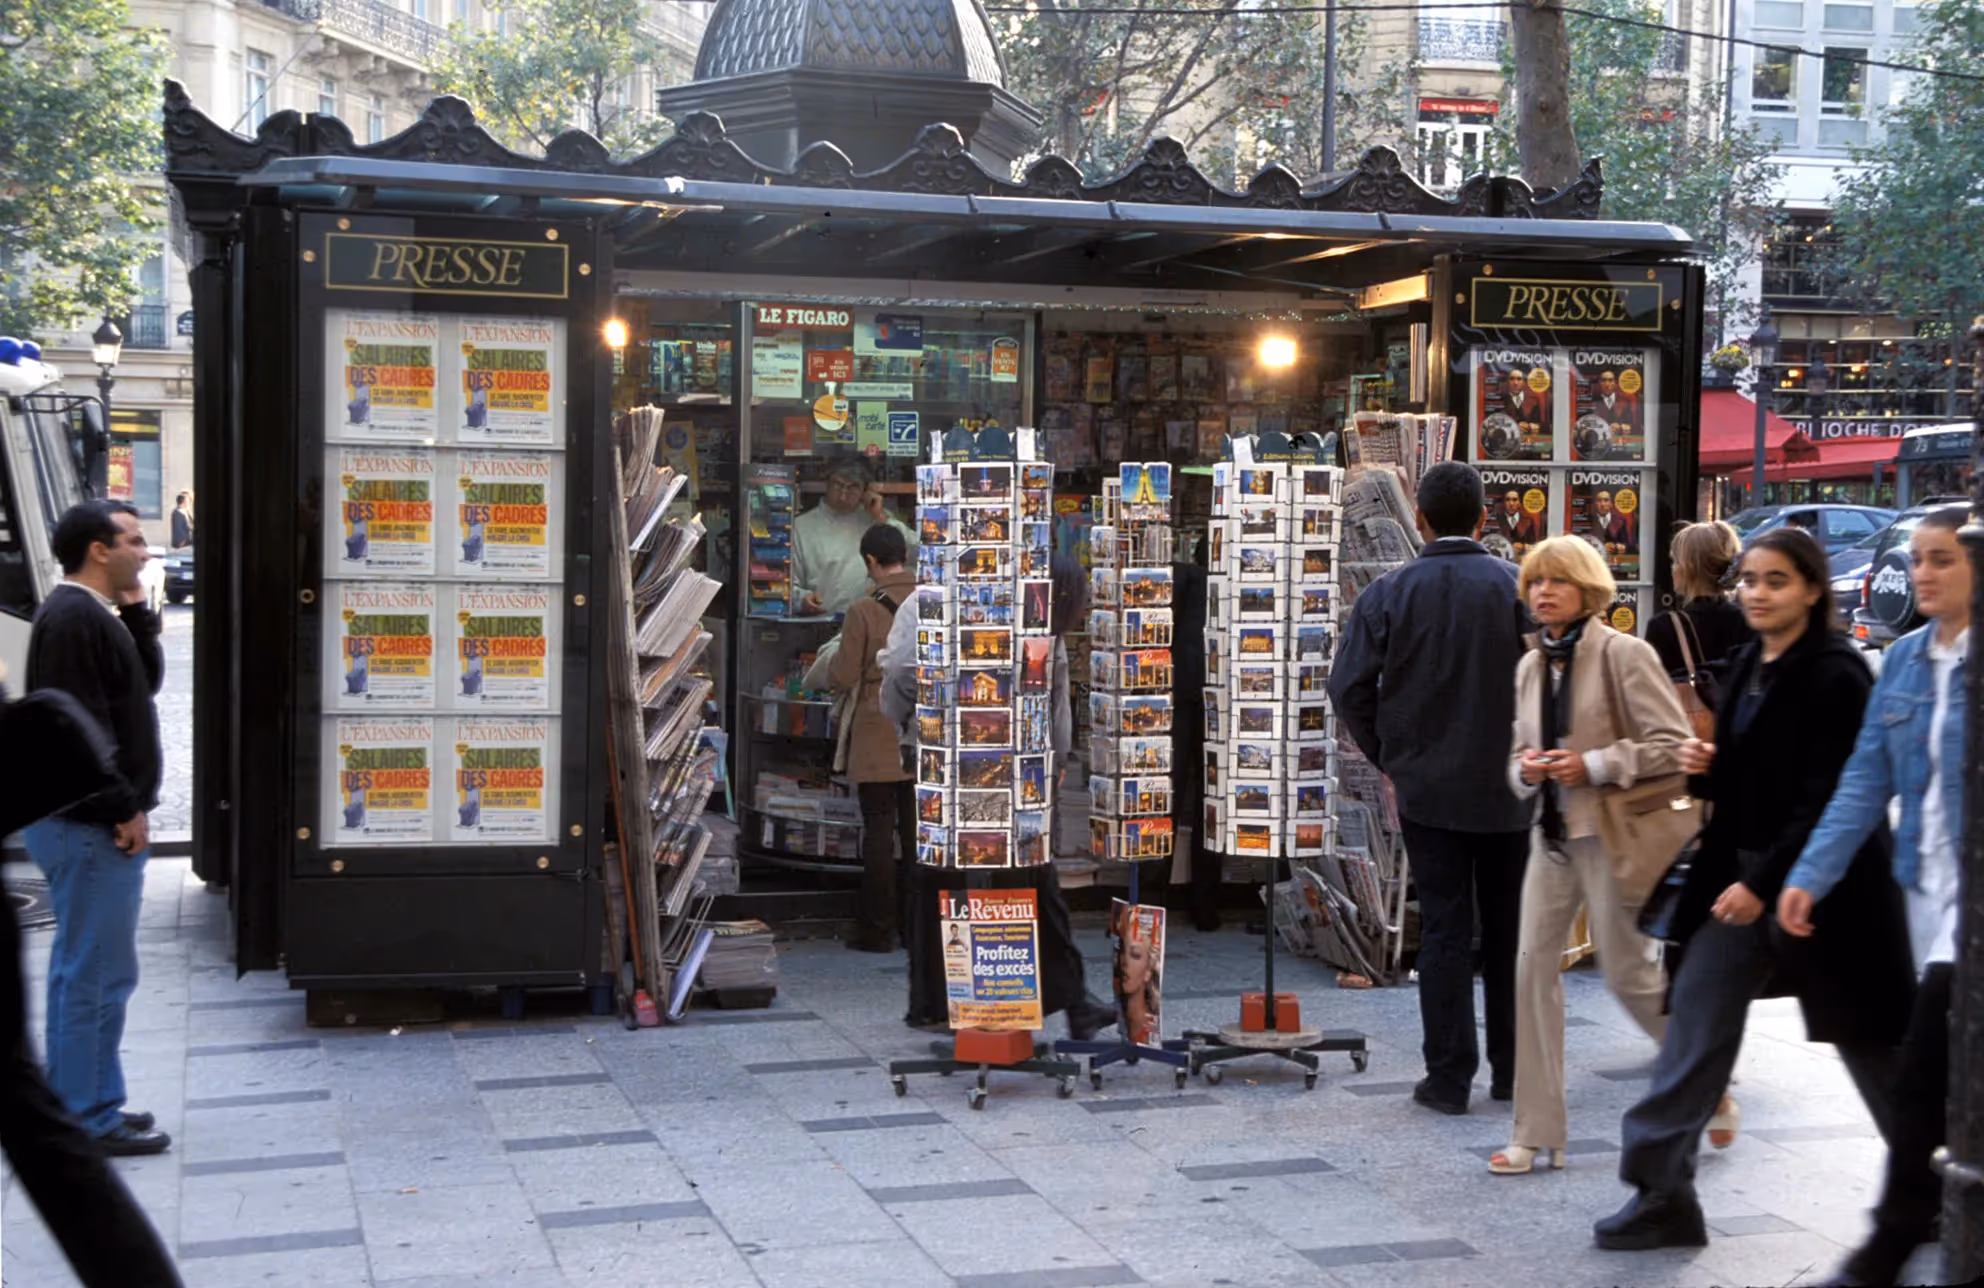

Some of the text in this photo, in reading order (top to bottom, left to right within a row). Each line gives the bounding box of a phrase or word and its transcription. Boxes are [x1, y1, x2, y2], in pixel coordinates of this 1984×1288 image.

[368, 243, 526, 288] PRESSE
[1503, 285, 1629, 325] PRESSE
[759, 307, 849, 326] LE FIGARO
[344, 320, 437, 339] L'EXPANSION
[462, 325, 552, 343] L'EXPANSION
[353, 344, 430, 366] SALAIRES
[471, 349, 545, 371] SALAIRES
[350, 367, 435, 388] DES CADRES
[467, 371, 550, 391] DES CADRES
[342, 455, 433, 473] L'EXPANSION
[460, 458, 549, 476] L'EXPANSION
[352, 480, 428, 501] SALAIRES
[469, 483, 543, 504] SALAIRES
[348, 502, 432, 522] DES CADRES
[464, 505, 547, 524] DES CADRES
[343, 591, 433, 608] L'EXPANSION
[459, 593, 547, 609] L'EXPANSION
[352, 615, 427, 636] SALAIRES
[468, 616, 541, 637] SALAIRES
[348, 637, 432, 656] DES CADRES
[463, 637, 546, 657] DES CADRES
[341, 724, 432, 740] L'EXPANSION
[456, 724, 545, 740] L'EXPANSION
[349, 748, 425, 769] SALAIRES
[466, 748, 539, 768] SALAIRES
[345, 769, 430, 789] DES CADRES
[461, 768, 543, 788] DES CADRES
[949, 898, 1034, 920] Le Revenu
[976, 945, 1029, 960] Profitez
[973, 961, 1035, 976] des excès
